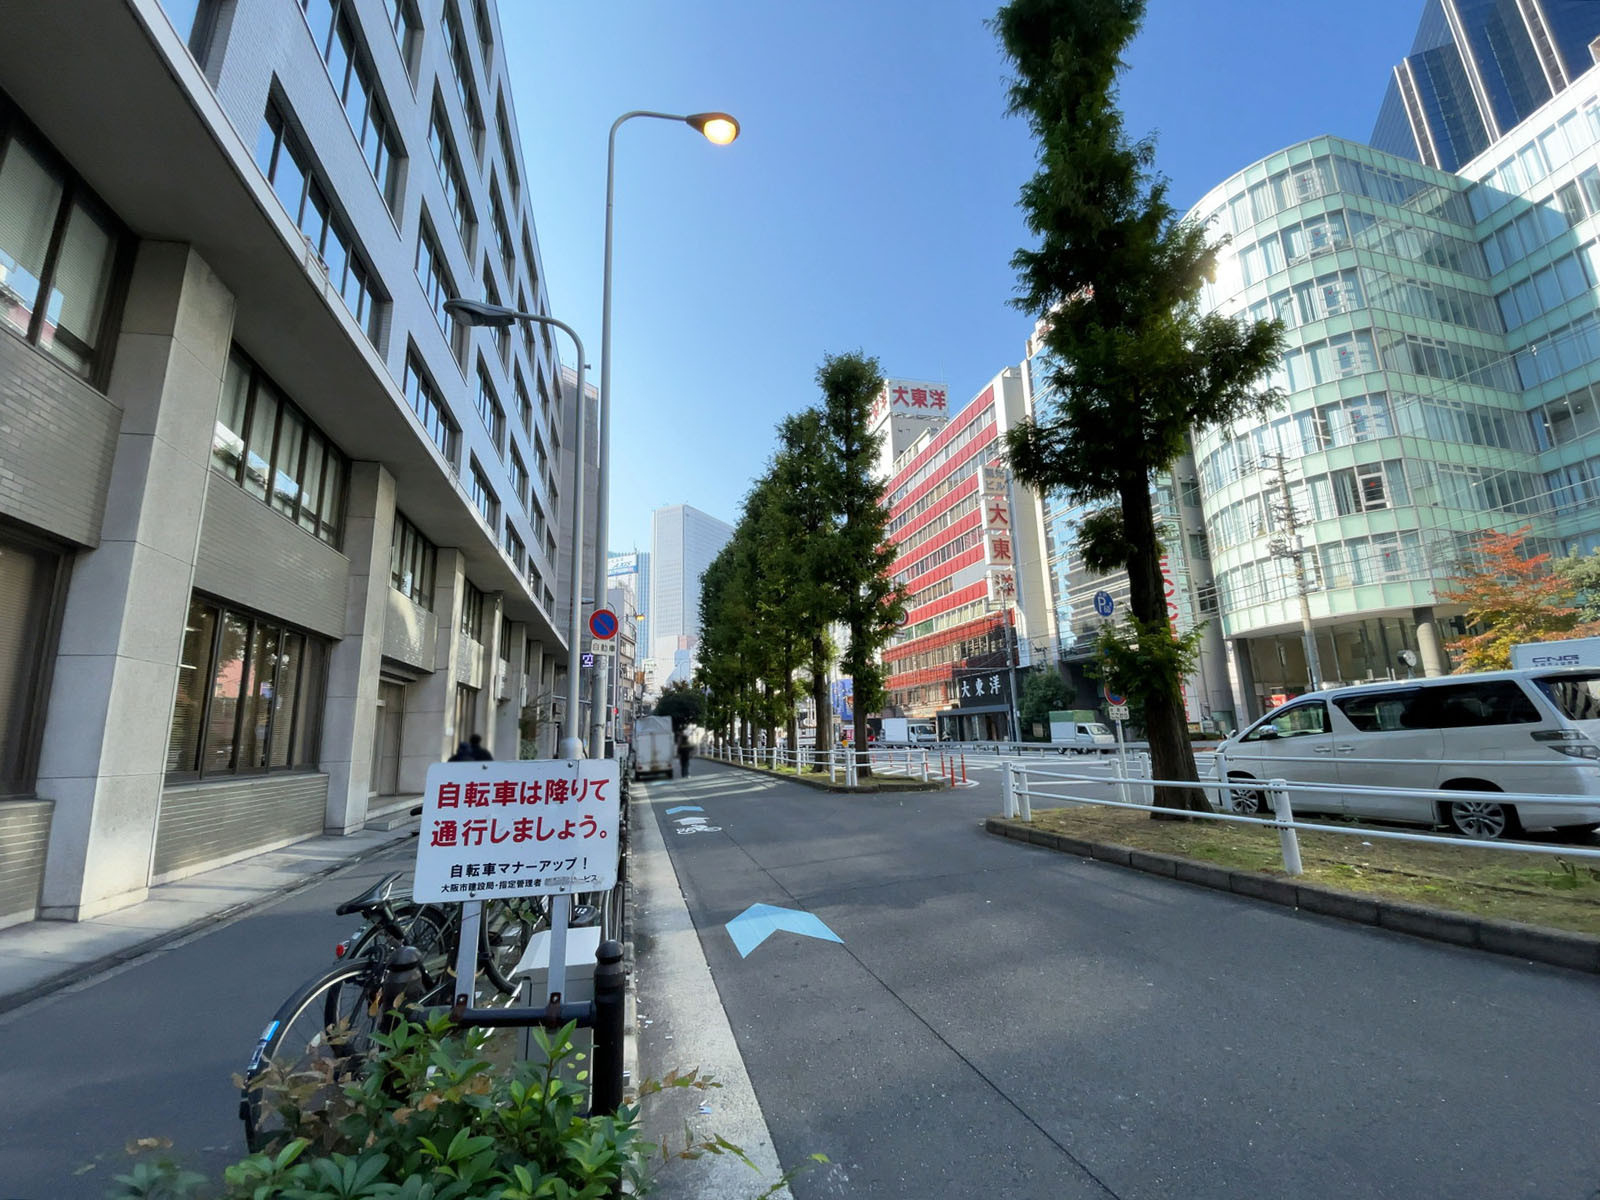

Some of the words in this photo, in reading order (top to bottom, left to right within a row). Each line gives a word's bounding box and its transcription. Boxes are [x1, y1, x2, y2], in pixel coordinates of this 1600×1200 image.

[892, 386, 946, 411] 大東洋
[988, 503, 1015, 597] 大東洋
[961, 674, 1001, 698] 大東洋
[437, 778, 610, 809] 自転車は降りて
[430, 815, 607, 847] 通行しましょう。
[450, 857, 588, 878] 自転車マナーアップ！
